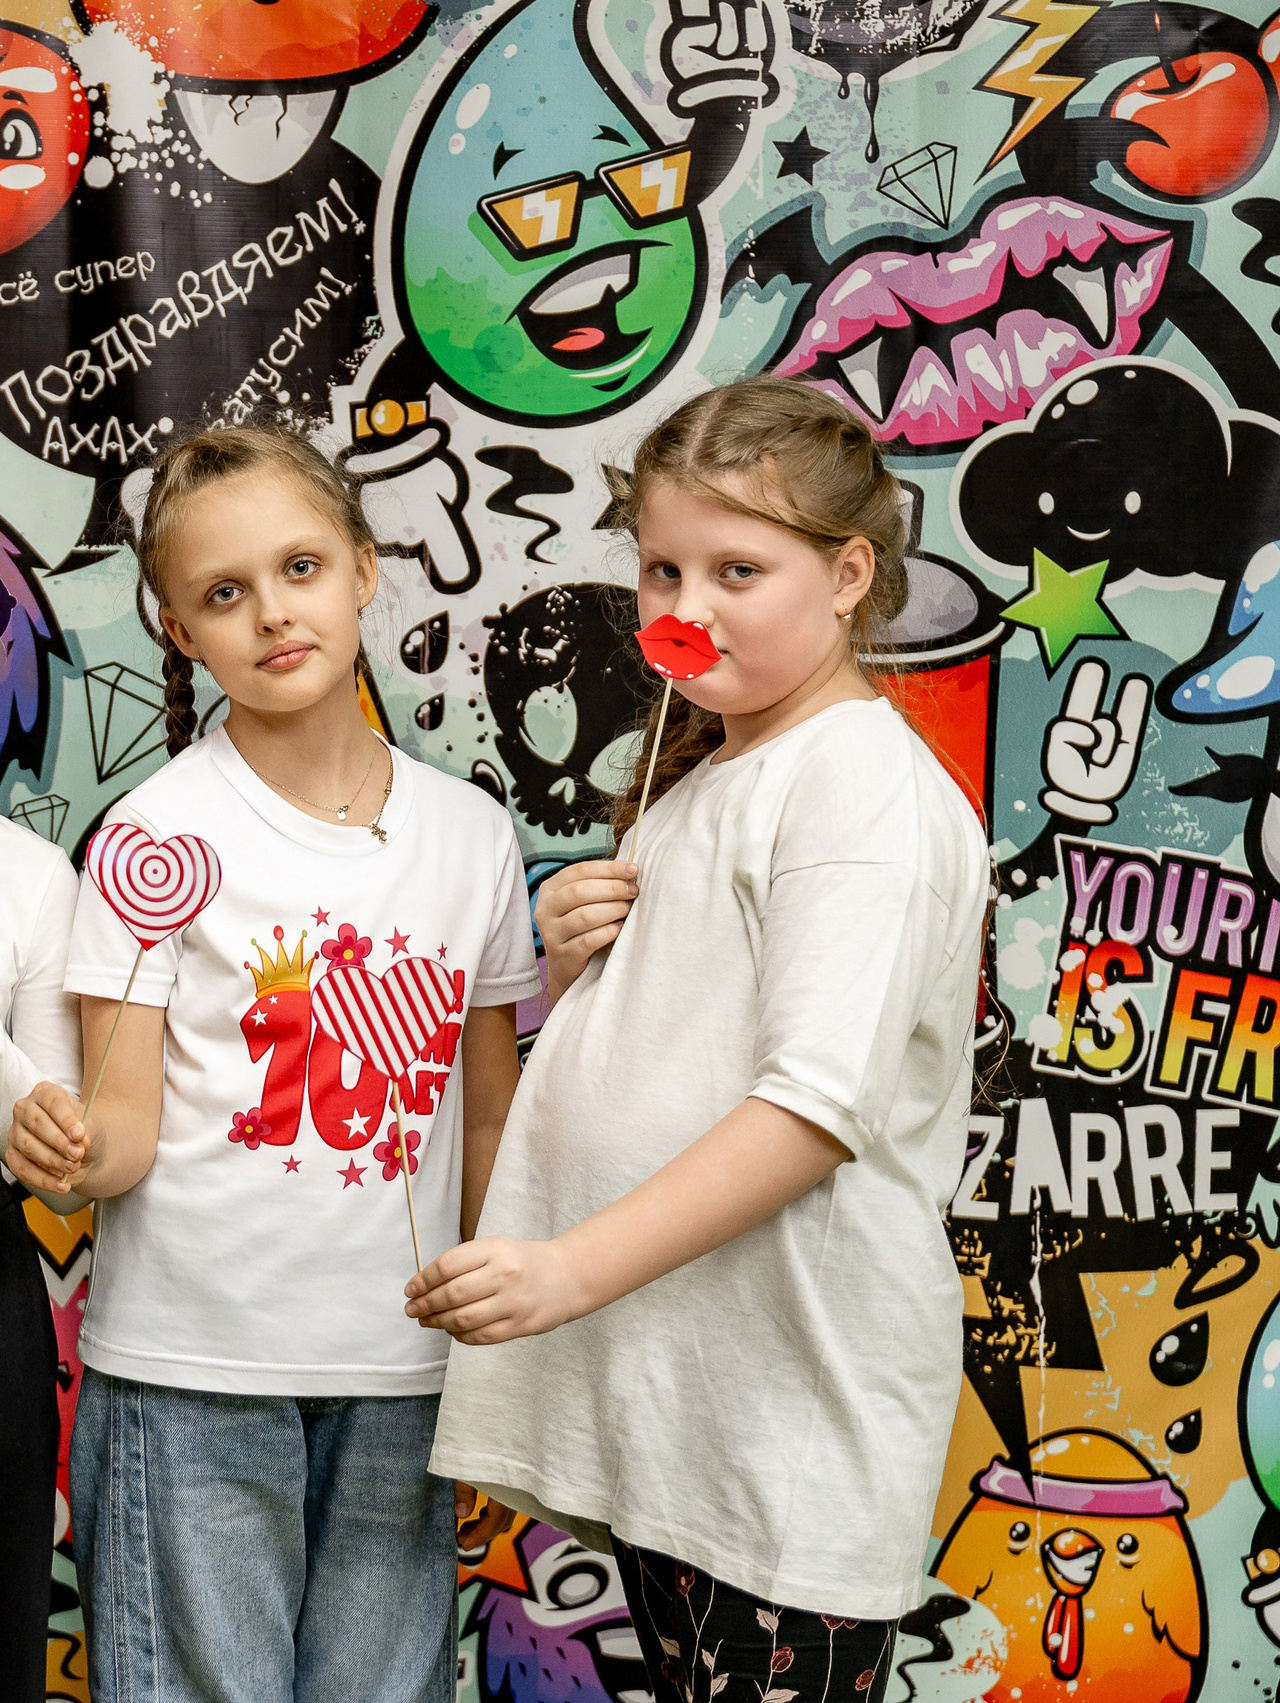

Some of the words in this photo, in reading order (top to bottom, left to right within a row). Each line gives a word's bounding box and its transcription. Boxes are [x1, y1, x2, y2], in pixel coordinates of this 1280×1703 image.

[53, 250, 156, 294] супер
[206, 266, 354, 432] атусим!
[1069, 850, 1256, 968] YOUR
